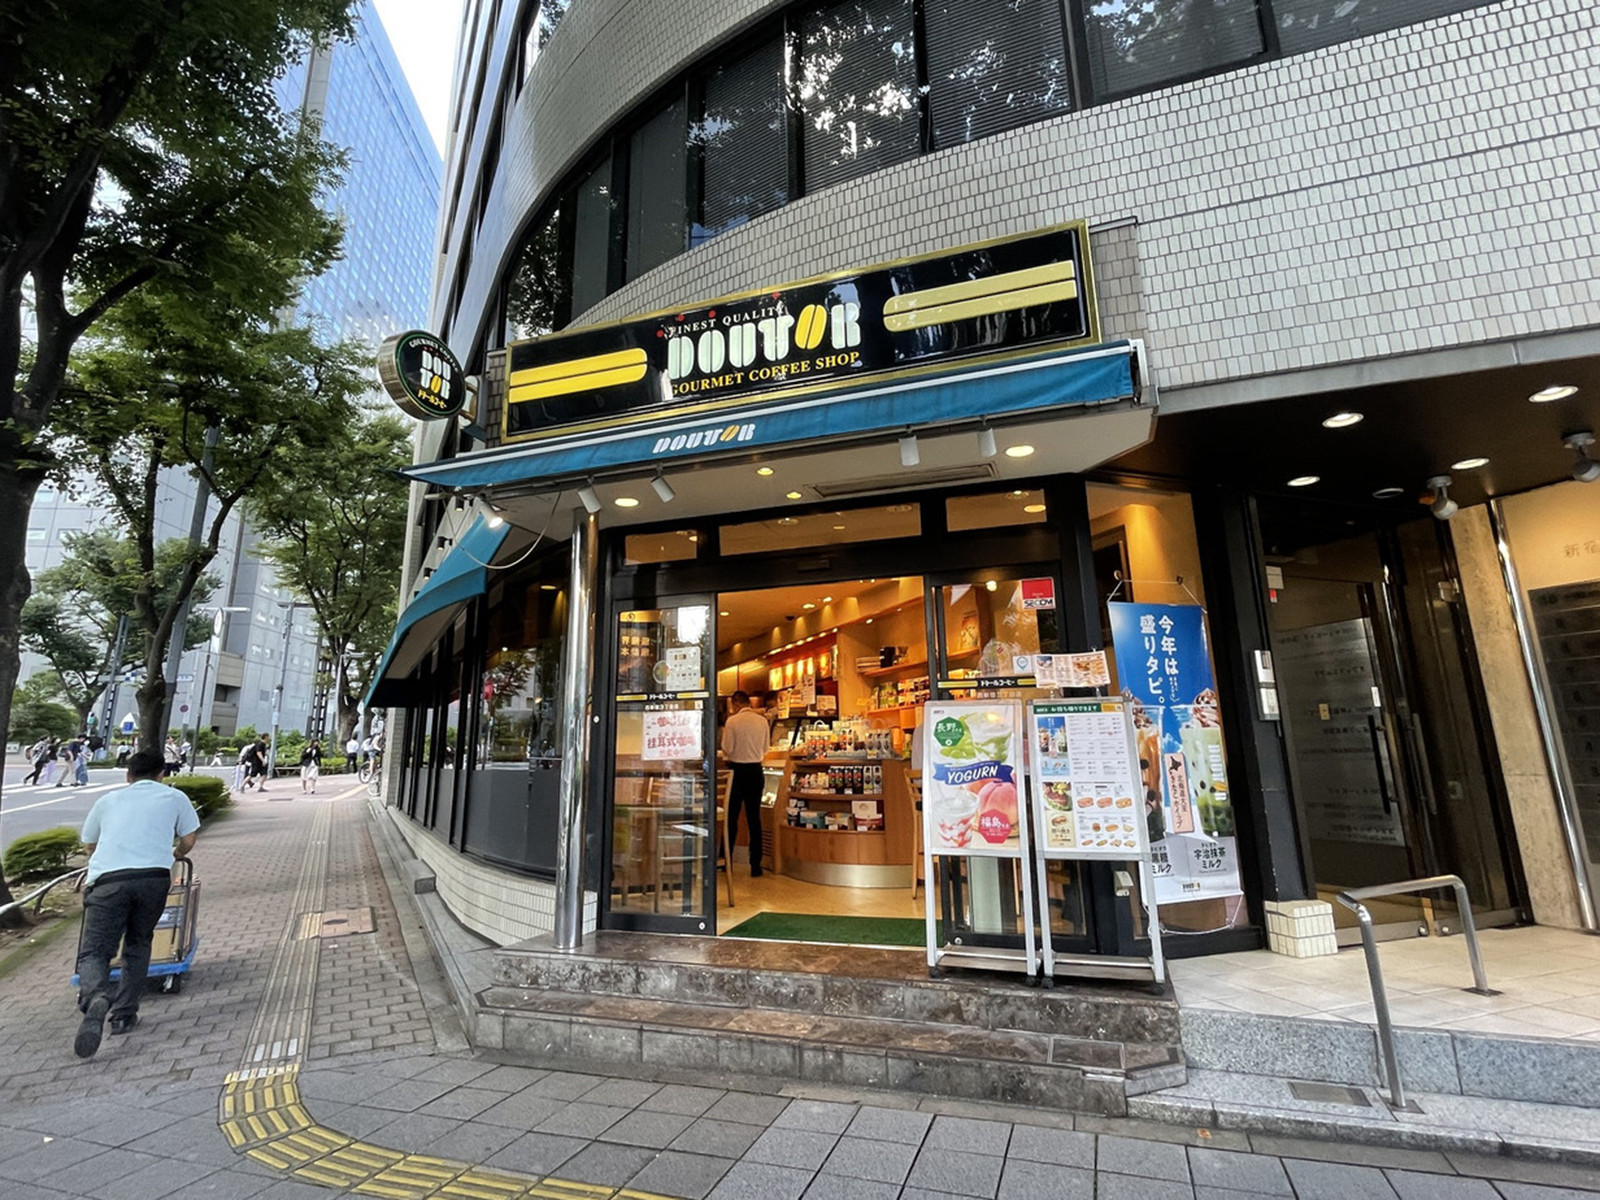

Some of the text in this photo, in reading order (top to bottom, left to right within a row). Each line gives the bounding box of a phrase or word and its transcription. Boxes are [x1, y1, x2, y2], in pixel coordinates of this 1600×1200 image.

[667, 302, 861, 380] DOUTOR
[671, 351, 860, 396] GOURMET COFFEE SHOP
[652, 423, 756, 454] DOUTOR
[1024, 598, 1053, 607] SECOM
[1158, 615, 1179, 675] 今年は
[1140, 614, 1165, 704] 盛りタピ。
[946, 765, 998, 784] YOGURN
[1194, 847, 1226, 860] 宇治抹茶
[1202, 859, 1222, 869] ミルク
[1152, 863, 1172, 874] ミルク
